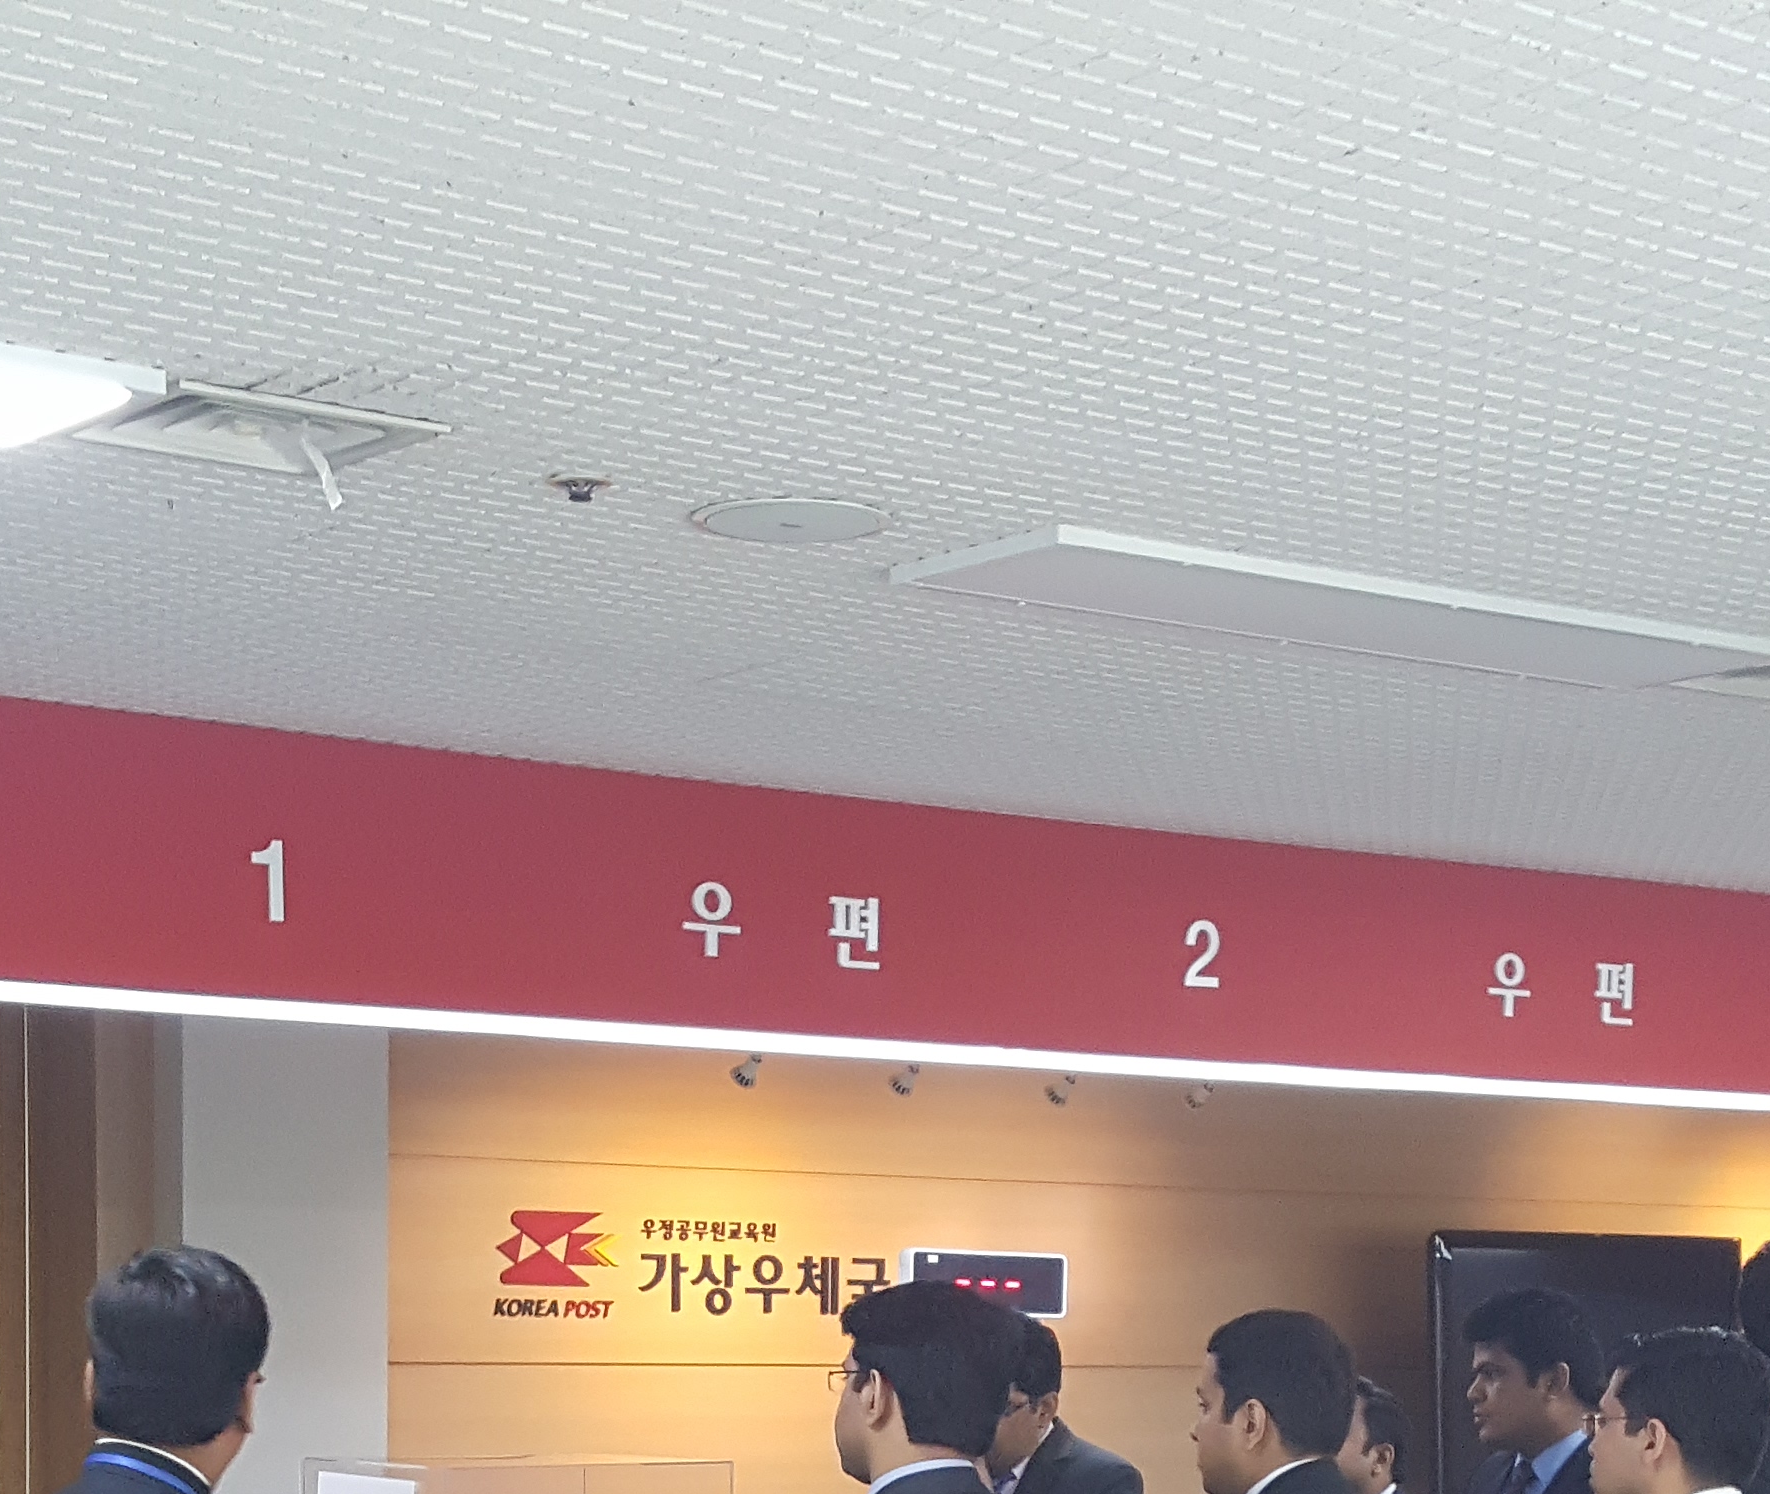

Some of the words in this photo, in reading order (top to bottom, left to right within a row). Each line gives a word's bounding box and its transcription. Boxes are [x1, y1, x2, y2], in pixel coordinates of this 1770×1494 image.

[250, 839, 285, 923] 1
[1183, 920, 1221, 989] 2
[640, 1218, 778, 1242] 우정공무원교육원
[637, 1252, 891, 1317] 가상우체국
[493, 1298, 559, 1318] KOREA
[563, 1299, 615, 1319] POST
